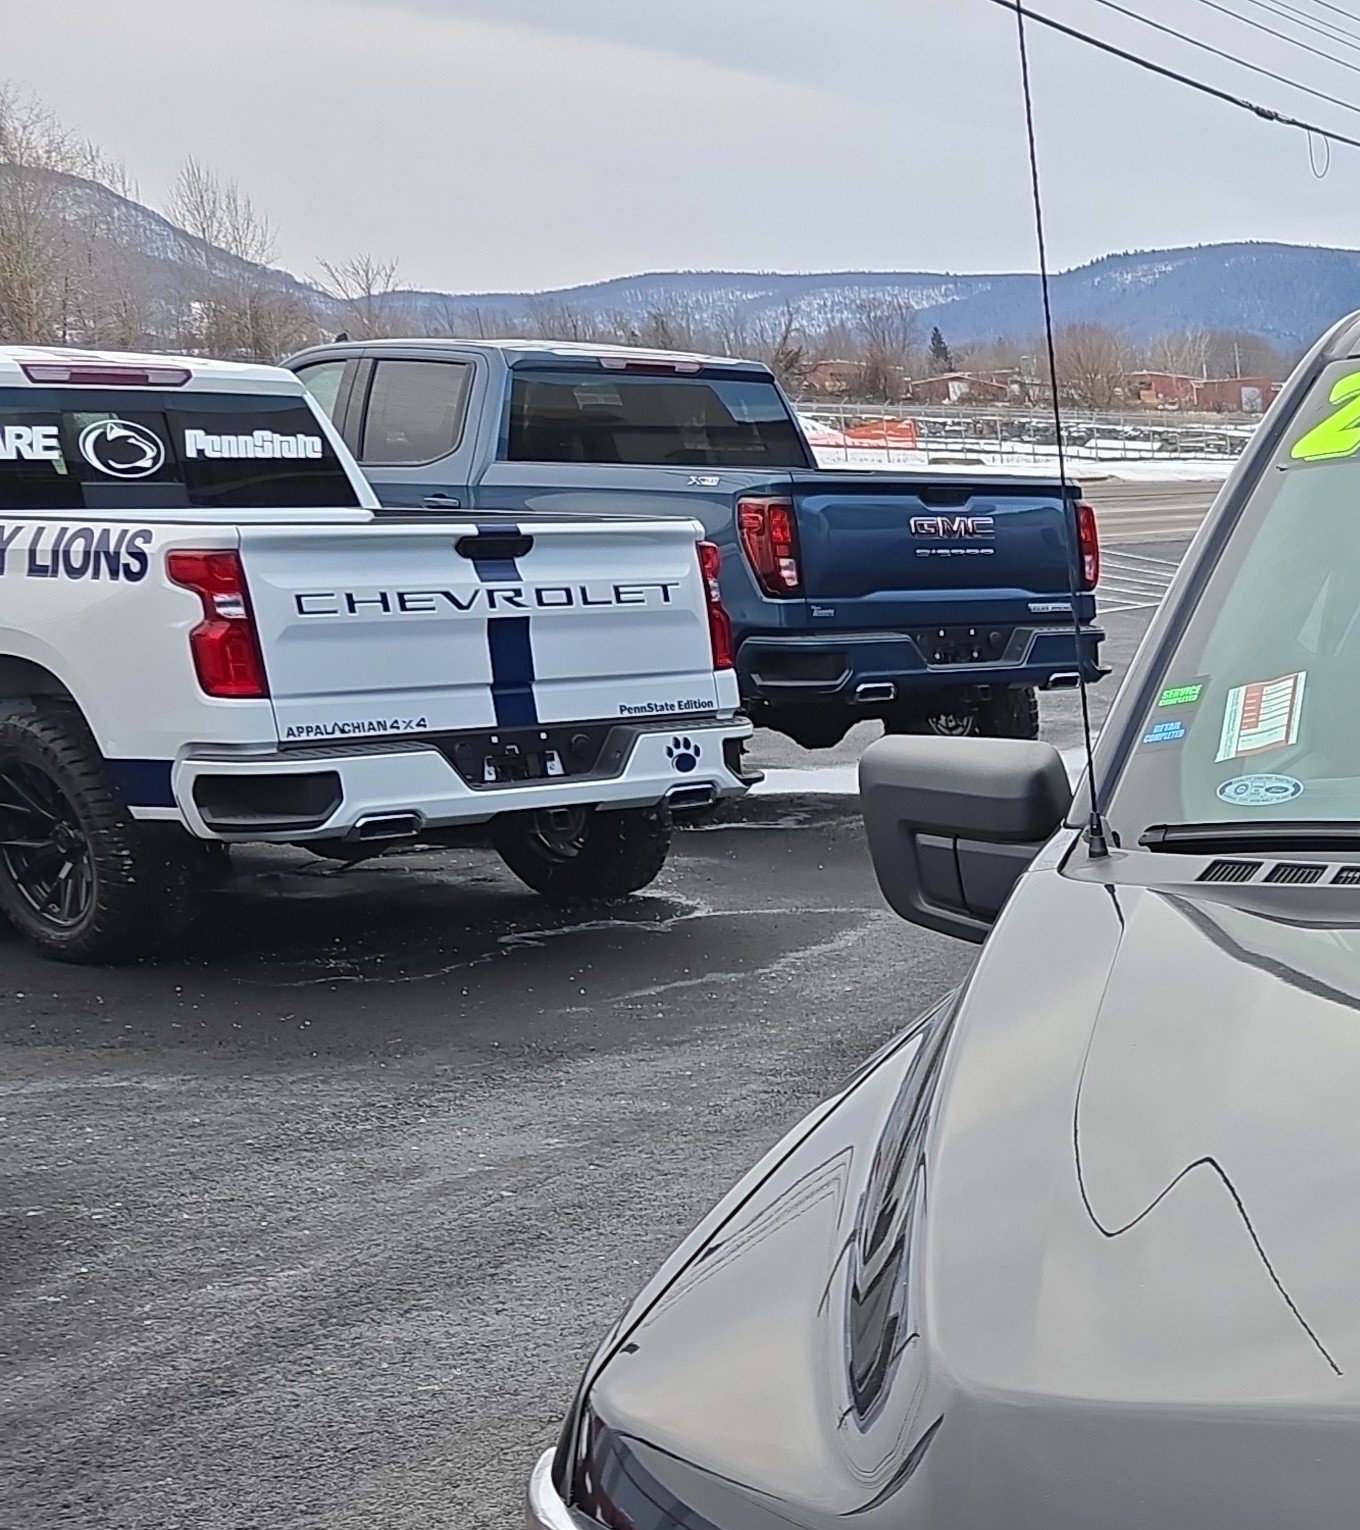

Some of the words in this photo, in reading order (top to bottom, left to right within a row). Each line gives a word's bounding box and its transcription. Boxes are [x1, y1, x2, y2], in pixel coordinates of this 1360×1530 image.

[184, 429, 323, 459] PennState
[909, 516, 996, 540] GMC
[27, 526, 153, 583] LIONS
[294, 582, 681, 616] CHEVROLET
[619, 702, 676, 715] PennState
[677, 698, 714, 711] Edition
[286, 720, 388, 738] APPALACHIAN
